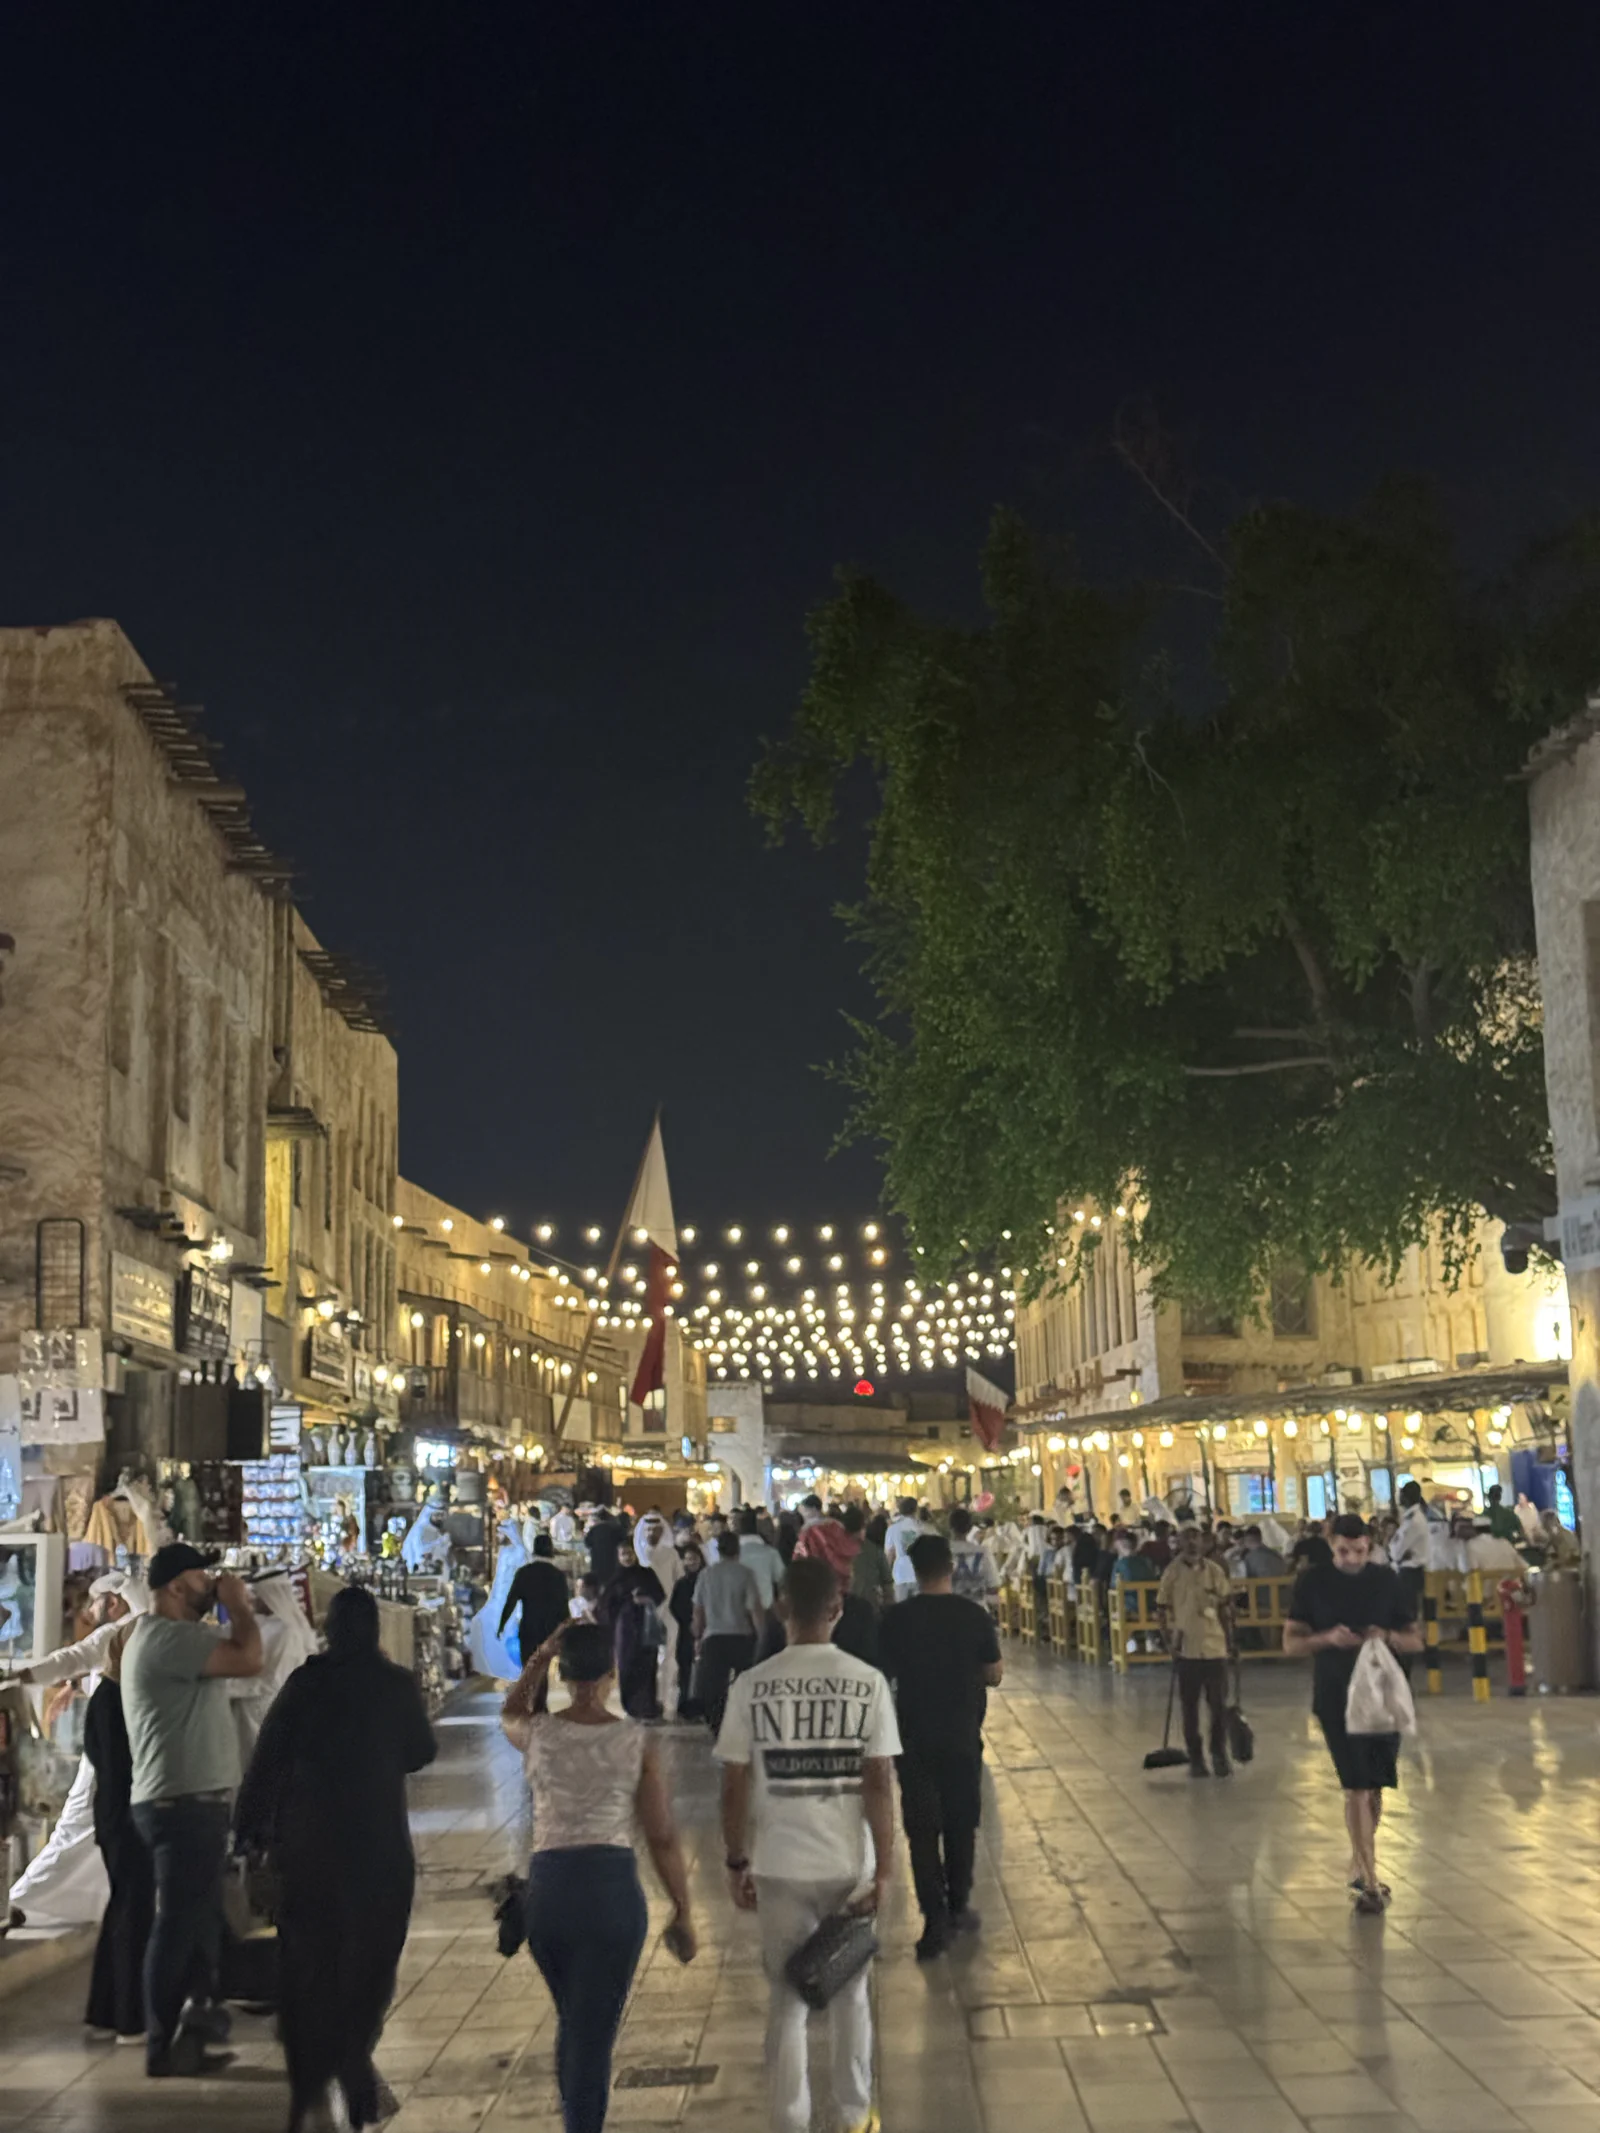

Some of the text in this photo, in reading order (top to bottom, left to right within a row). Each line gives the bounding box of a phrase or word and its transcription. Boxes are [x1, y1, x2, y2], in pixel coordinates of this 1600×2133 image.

[753, 1677, 871, 1698] DESIGNED
[750, 1699, 873, 1742] IN HELL
